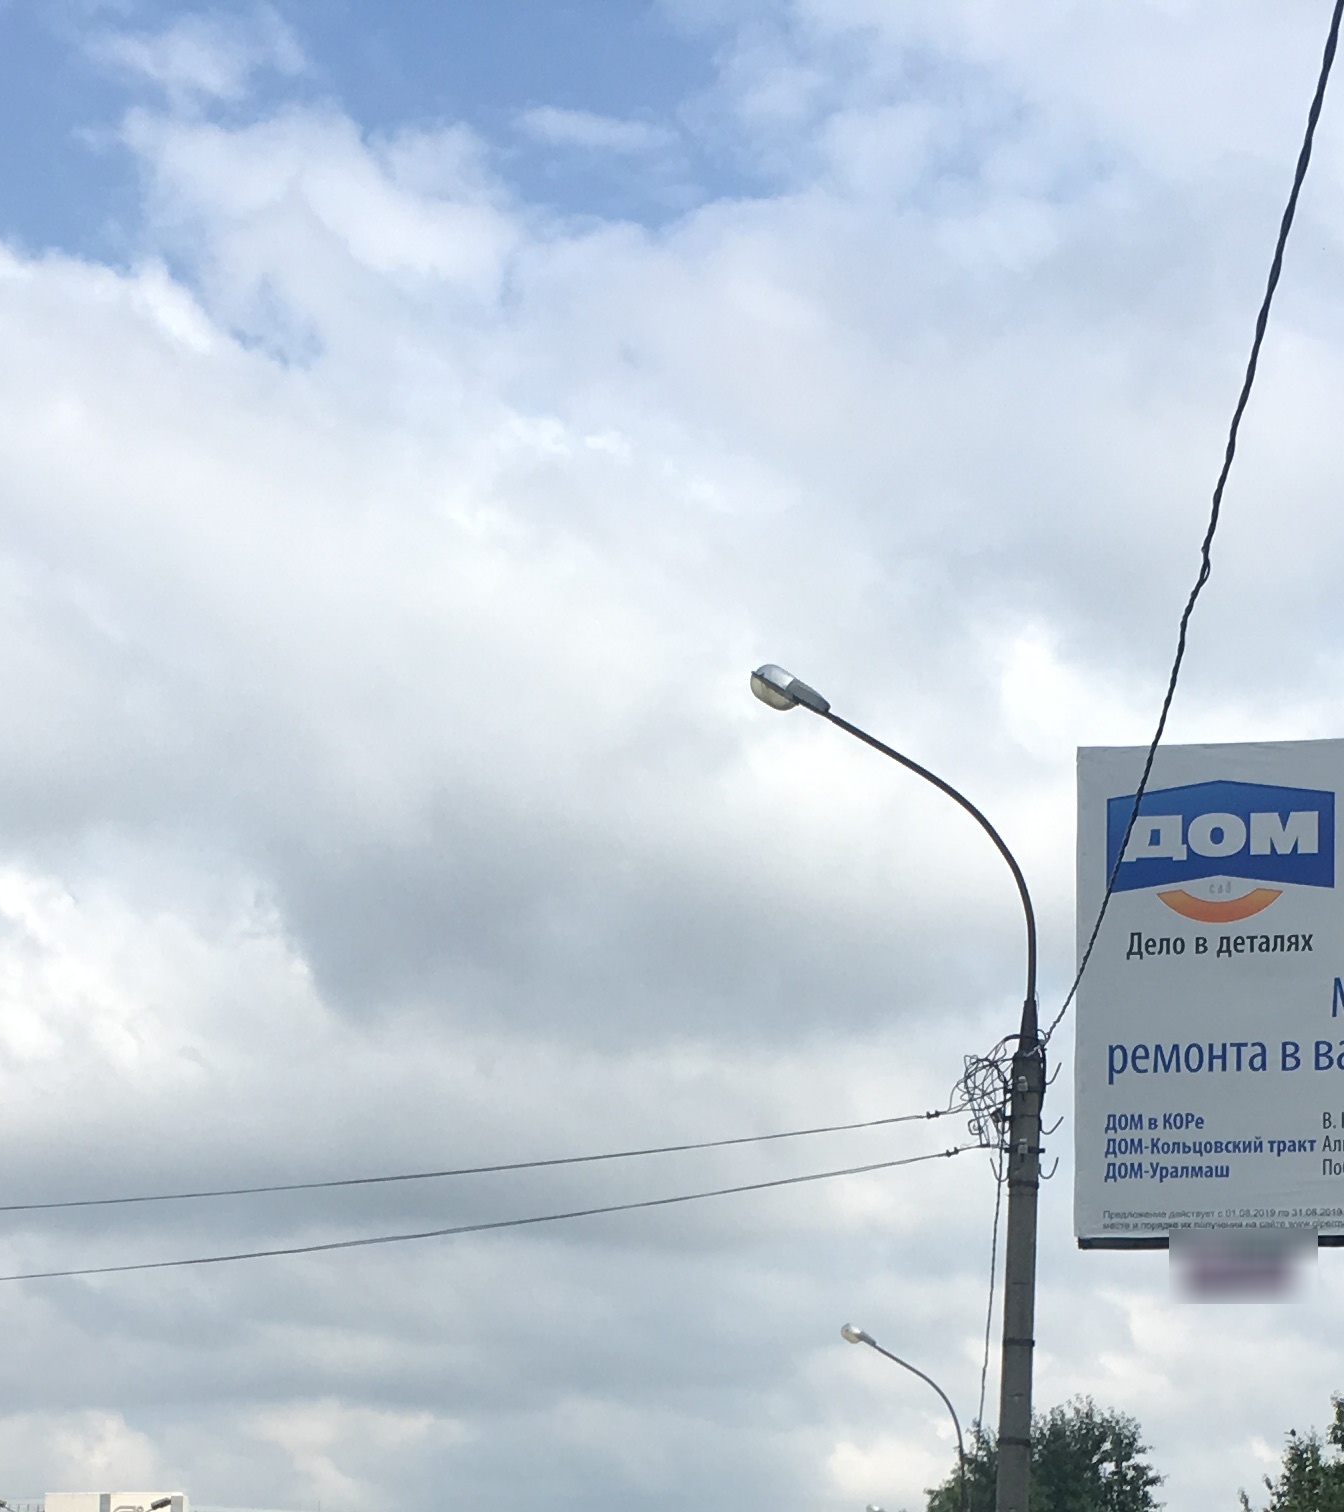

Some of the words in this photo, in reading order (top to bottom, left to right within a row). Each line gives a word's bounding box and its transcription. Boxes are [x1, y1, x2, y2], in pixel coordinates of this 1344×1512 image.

[1121, 811, 1319, 863] ДОМ
[1126, 932, 1186, 960] Дело
[1194, 936, 1209, 955] в
[1216, 933, 1314, 959] деталях
[1108, 1041, 1267, 1085] ремонта
[1280, 1041, 1302, 1072] в
[1105, 1113, 1144, 1134] ДОМ
[1147, 1117, 1159, 1130] в
[1162, 1113, 1205, 1130] КОРе
[1322, 1112, 1337, 1129] В.
[1105, 1136, 1264, 1159] ДОМ-Кольцовский
[1268, 1139, 1317, 1157] тракт
[1104, 1162, 1230, 1184] ДОМ-Уралмаш
